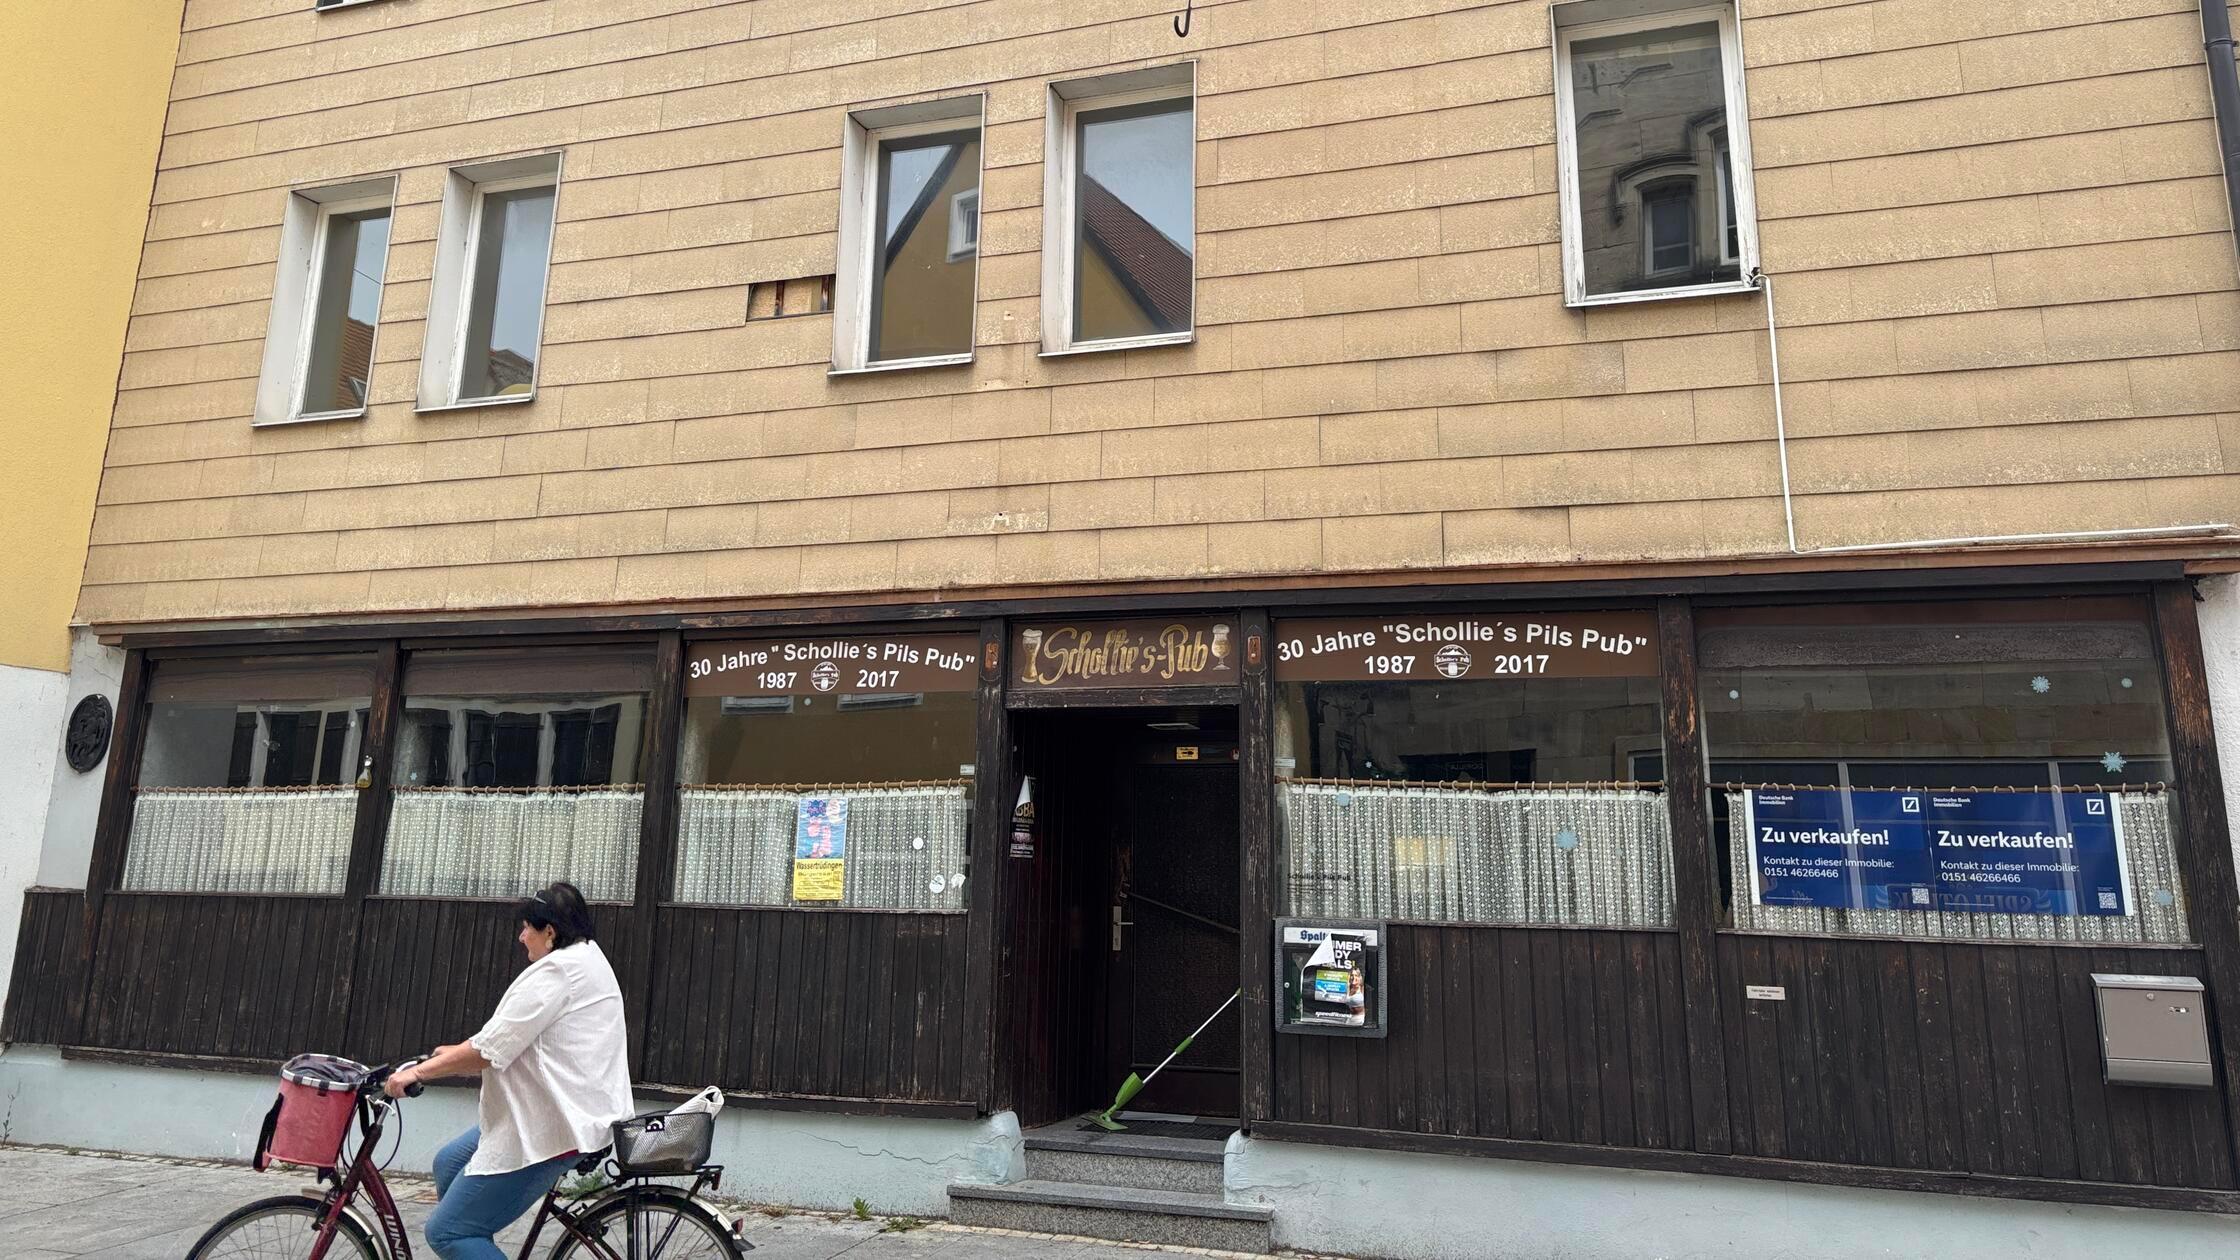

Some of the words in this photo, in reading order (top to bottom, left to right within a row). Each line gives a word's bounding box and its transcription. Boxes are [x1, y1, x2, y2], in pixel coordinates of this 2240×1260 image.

[1277, 639, 1304, 661] 30
[1311, 630, 1376, 655] Jahre
[1526, 623, 1573, 647] Pils
[1582, 628, 1647, 656] Pub"
[690, 658, 711, 678] 30
[717, 651, 767, 672] Jahre
[884, 643, 919, 664] Pils
[925, 648, 975, 671] Pub"
[1364, 655, 1416, 675] 1987
[1494, 654, 1550, 674] 2017
[757, 672, 797, 689] 1987
[856, 669, 900, 688] 2017
[1761, 827, 1785, 843] Zu
[1789, 828, 1889, 845] verkaufen!
[1937, 830, 1963, 847] Zu
[1967, 831, 2073, 849] verkaufen!
[1763, 856, 1799, 866] Kontakt
[1801, 858, 1813, 866] zu
[1814, 857, 1842, 867] dieser
[1845, 858, 1894, 868] Immobilie:
[1940, 861, 1979, 870] Kontakt
[1981, 863, 1993, 871] zu
[1995, 862, 2024, 871] dieser
[2027, 862, 2080, 872] Immobilie:
[1764, 867, 1788, 877] 0151
[1791, 868, 1838, 878] 46266466
[1941, 873, 1967, 882] 0151
[1969, 873, 2021, 883] 46266466
